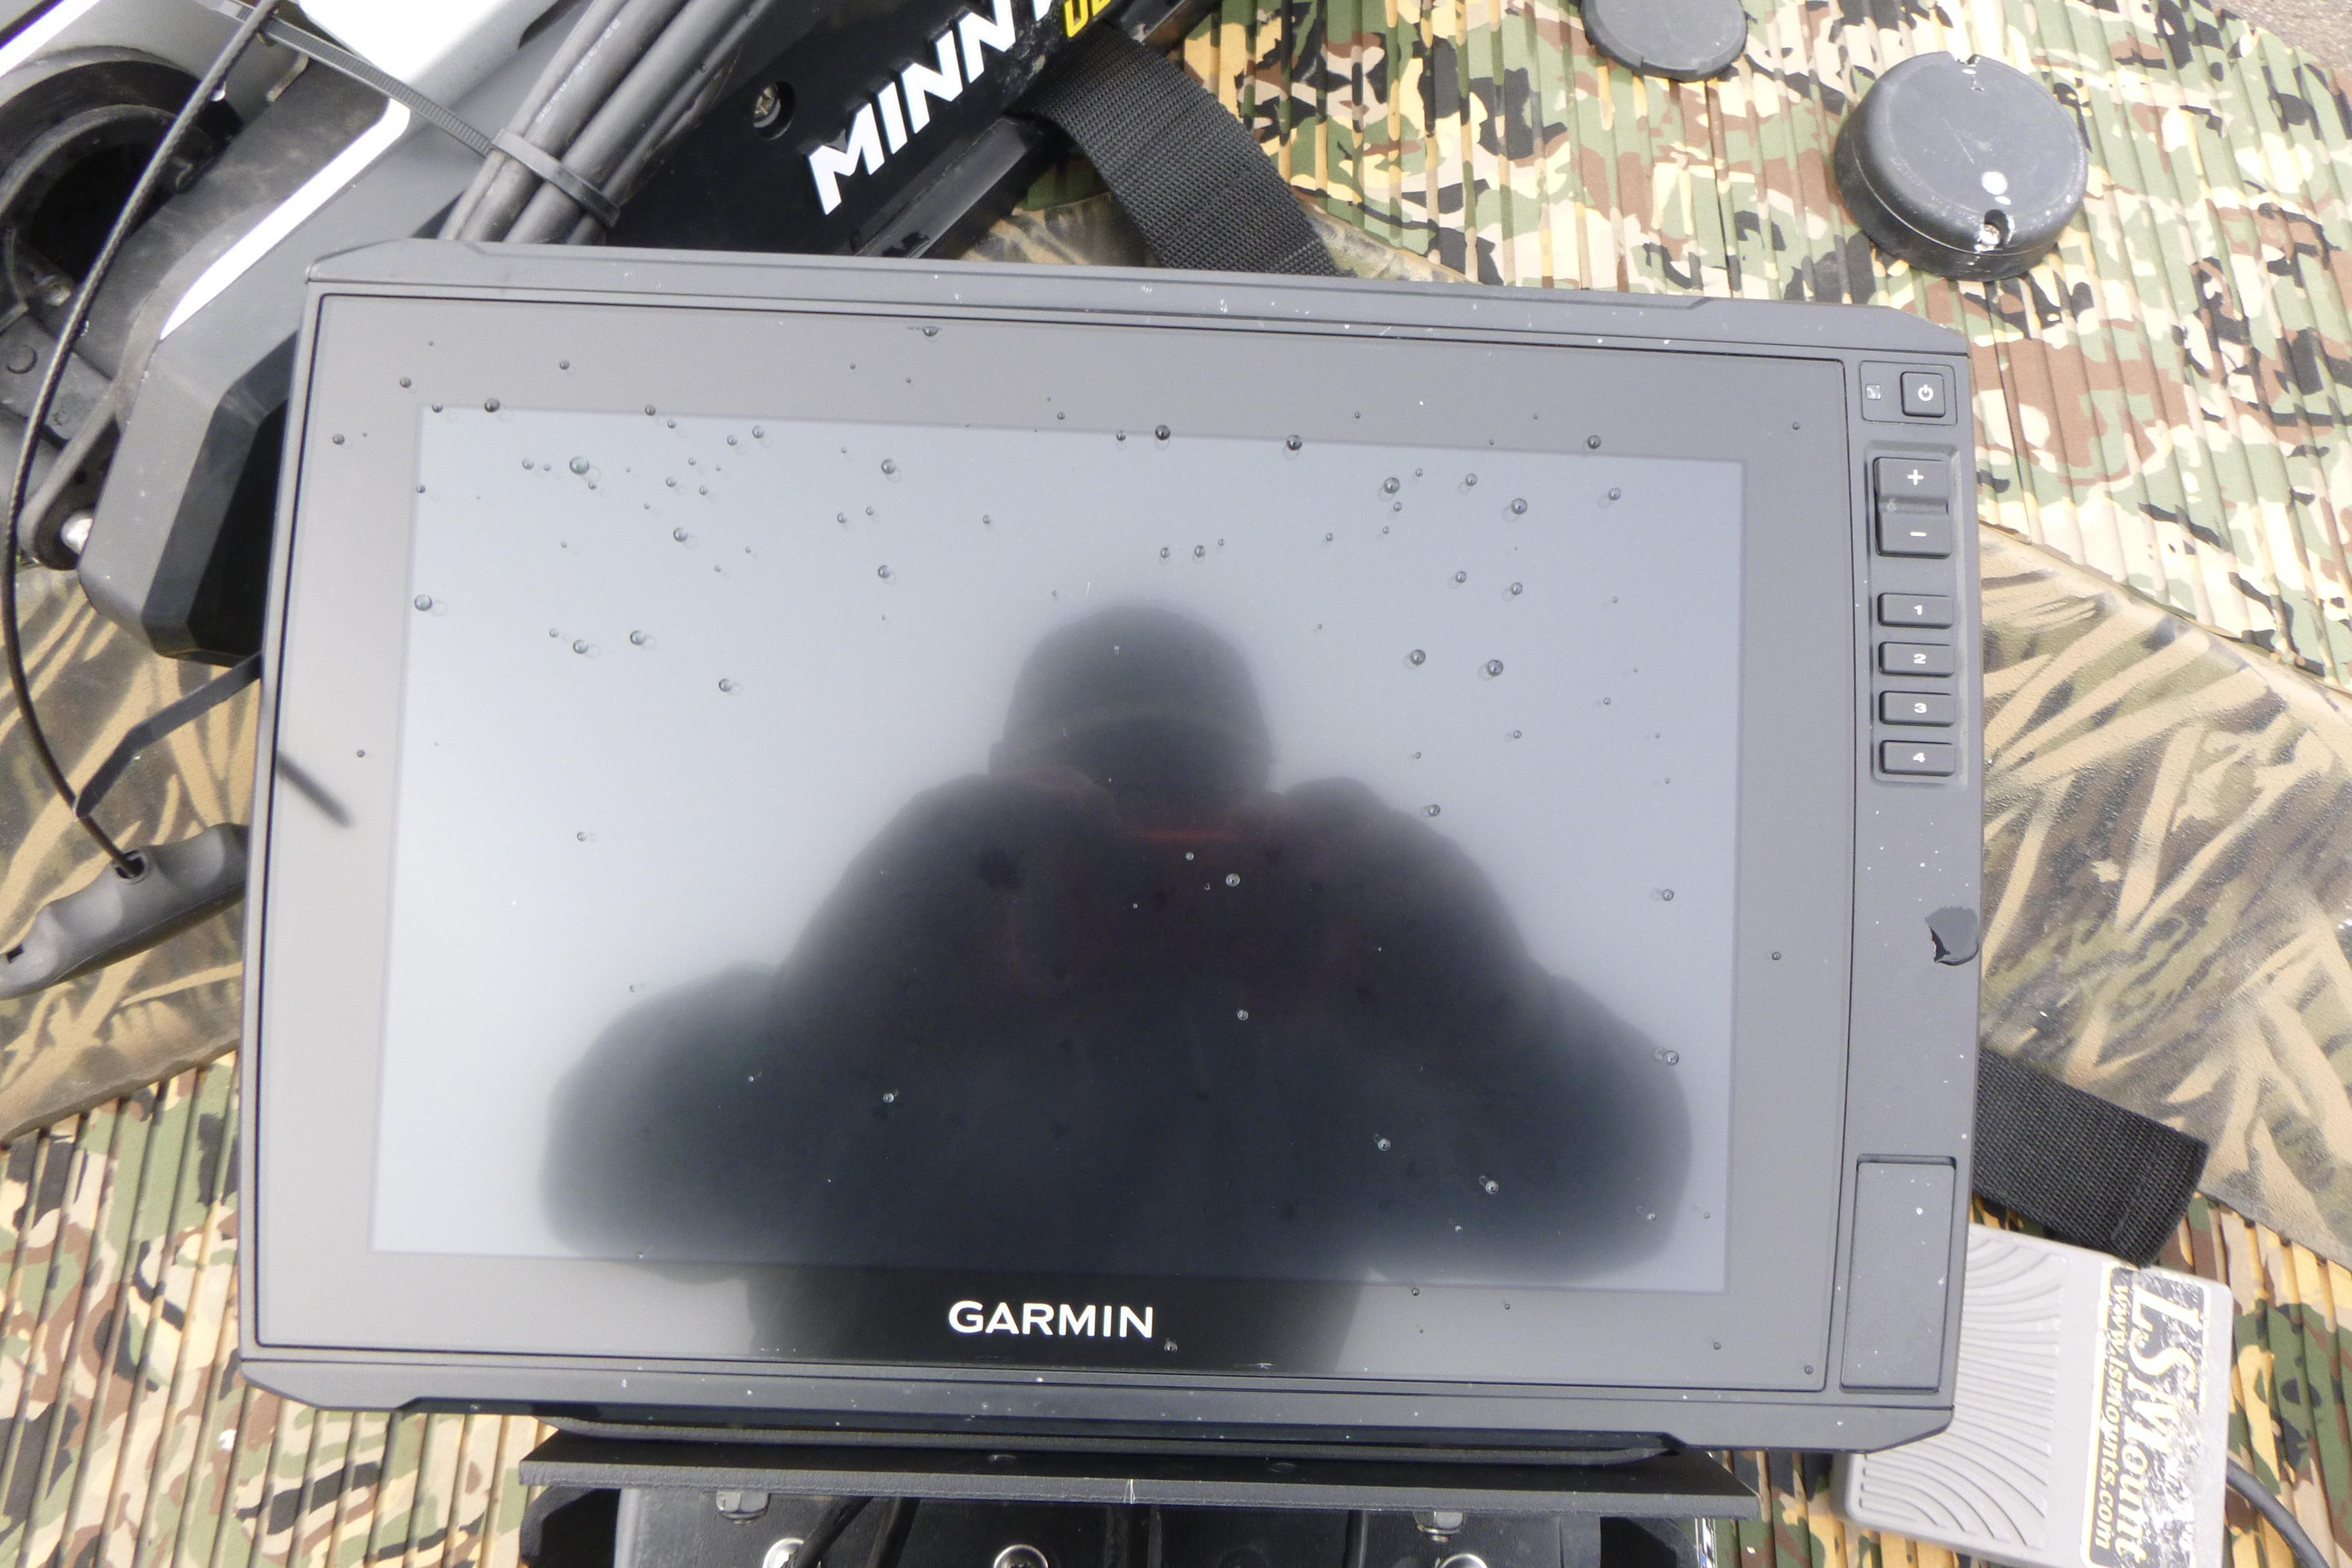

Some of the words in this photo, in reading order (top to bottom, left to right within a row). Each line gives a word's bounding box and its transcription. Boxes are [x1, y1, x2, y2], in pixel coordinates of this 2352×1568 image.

[808, 0, 1016, 215] MINN
[1914, 605, 1923, 615] 1
[1913, 653, 1926, 664] 2
[1914, 703, 1927, 714] 3
[1912, 752, 1926, 763] 4
[948, 1300, 1153, 1338] GARMIN
